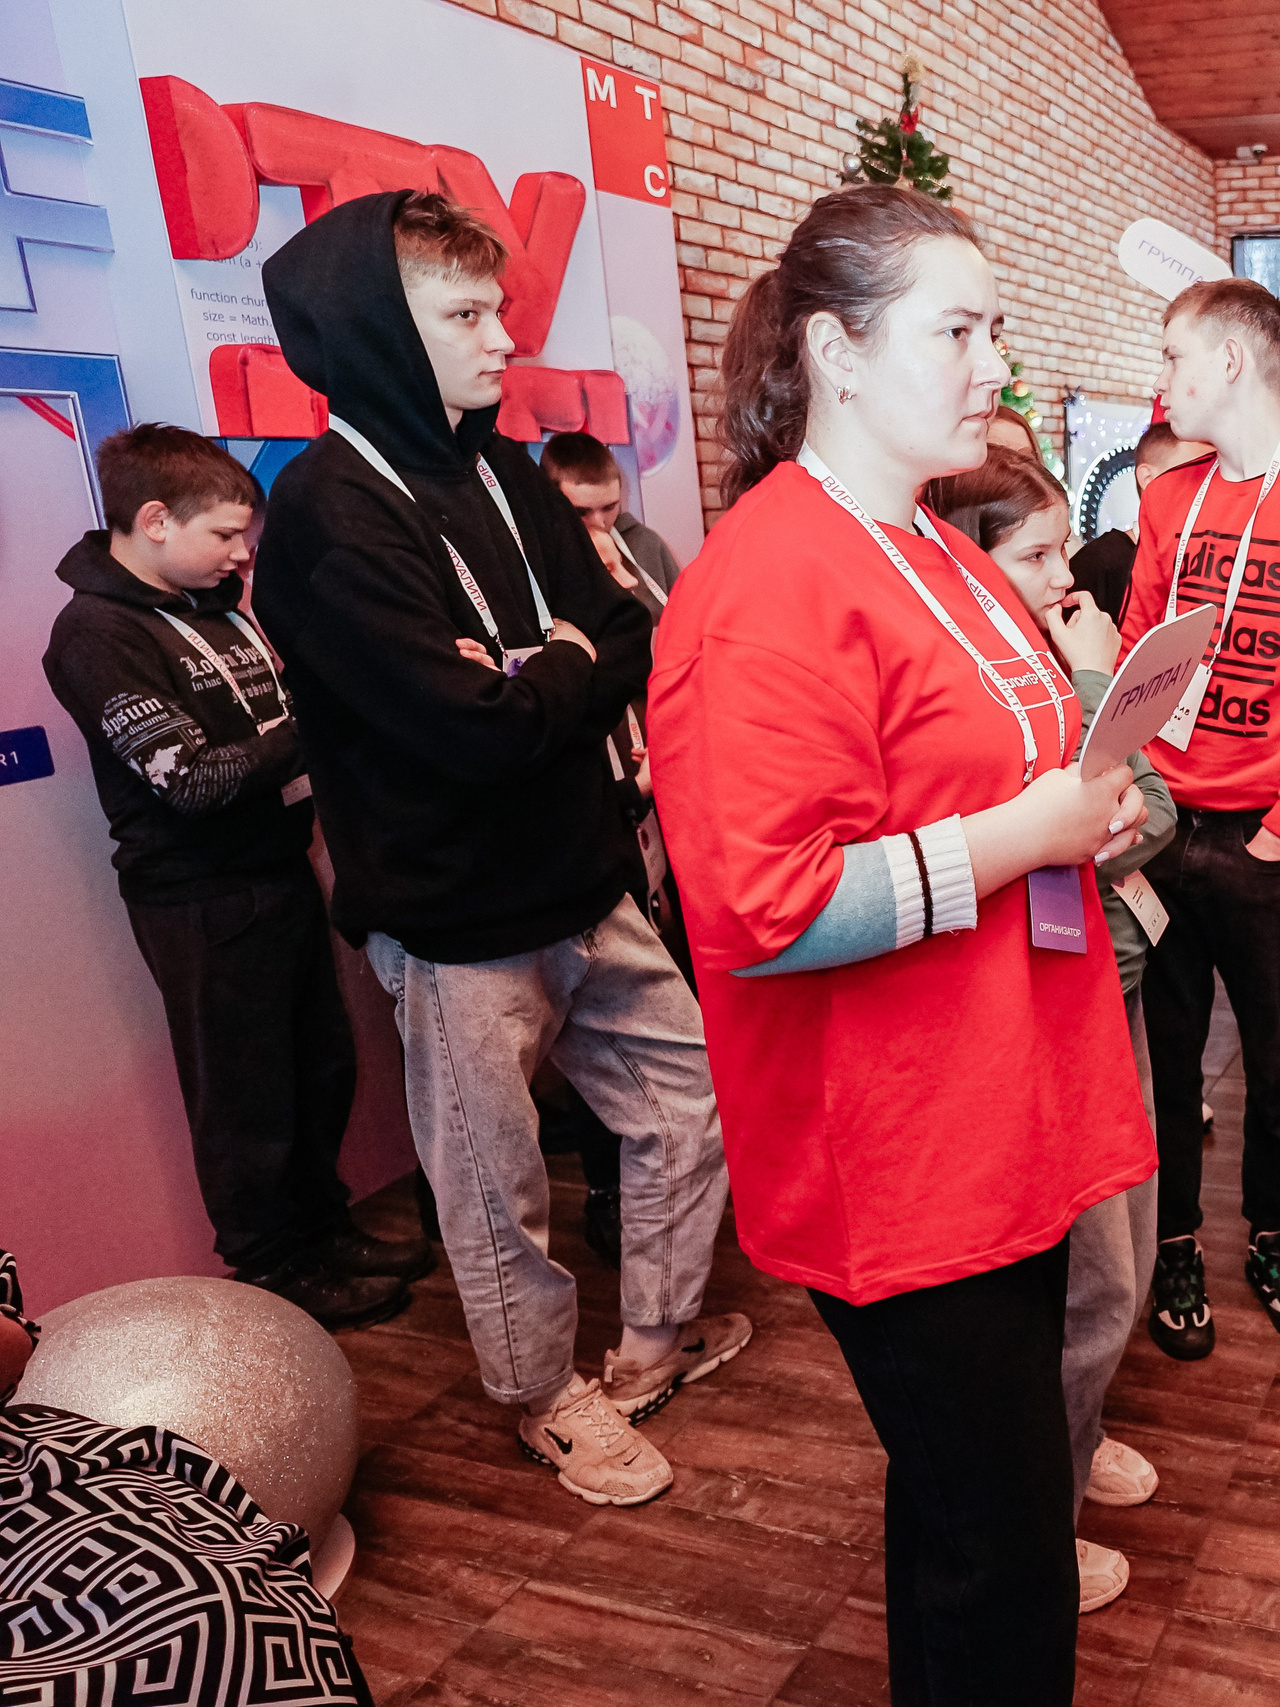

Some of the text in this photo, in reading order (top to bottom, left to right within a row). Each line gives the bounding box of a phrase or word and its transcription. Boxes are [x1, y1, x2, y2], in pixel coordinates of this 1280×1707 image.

[190, 288, 237, 304] function
[203, 311, 225, 322] size
[206, 331, 236, 343] const
[821, 475, 910, 571] ВИРТУАЛИТИ
[945, 620, 1027, 722] ВИРТУАЛИТИ
[191, 679, 204, 692] In
[204, 676, 222, 688] hac
[1003, 671, 1039, 689] ОЛОНТЁР
[1111, 657, 1192, 721] ГРУППА 1
[101, 697, 164, 738] Ipsum
[10, 751, 19, 765] 1
[1039, 922, 1082, 938] ОРГАНИЗАТОР
